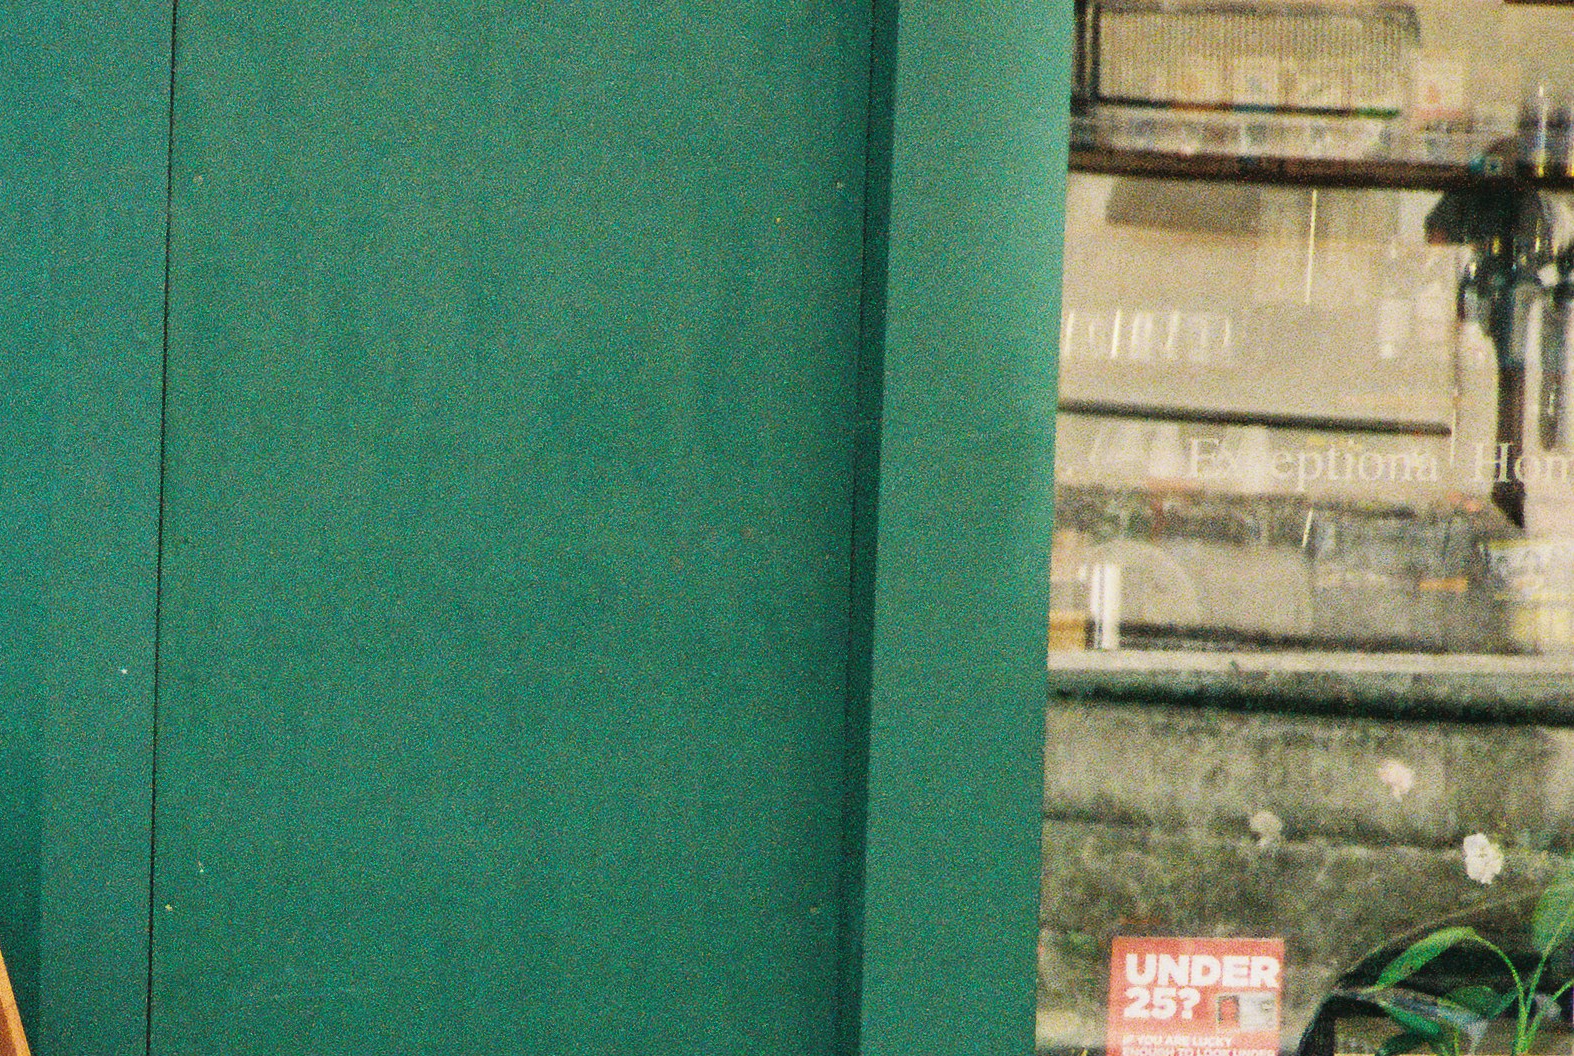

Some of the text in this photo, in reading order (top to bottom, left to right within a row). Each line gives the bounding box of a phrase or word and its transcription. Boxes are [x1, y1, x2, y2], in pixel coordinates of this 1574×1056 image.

[1125, 953, 1281, 988] UNDER
[1123, 986, 1201, 1020] 25?
[1136, 1035, 1163, 1046] YOU
[1165, 1035, 1190, 1047] ARE
[1192, 1036, 1233, 1048] LUCKY
